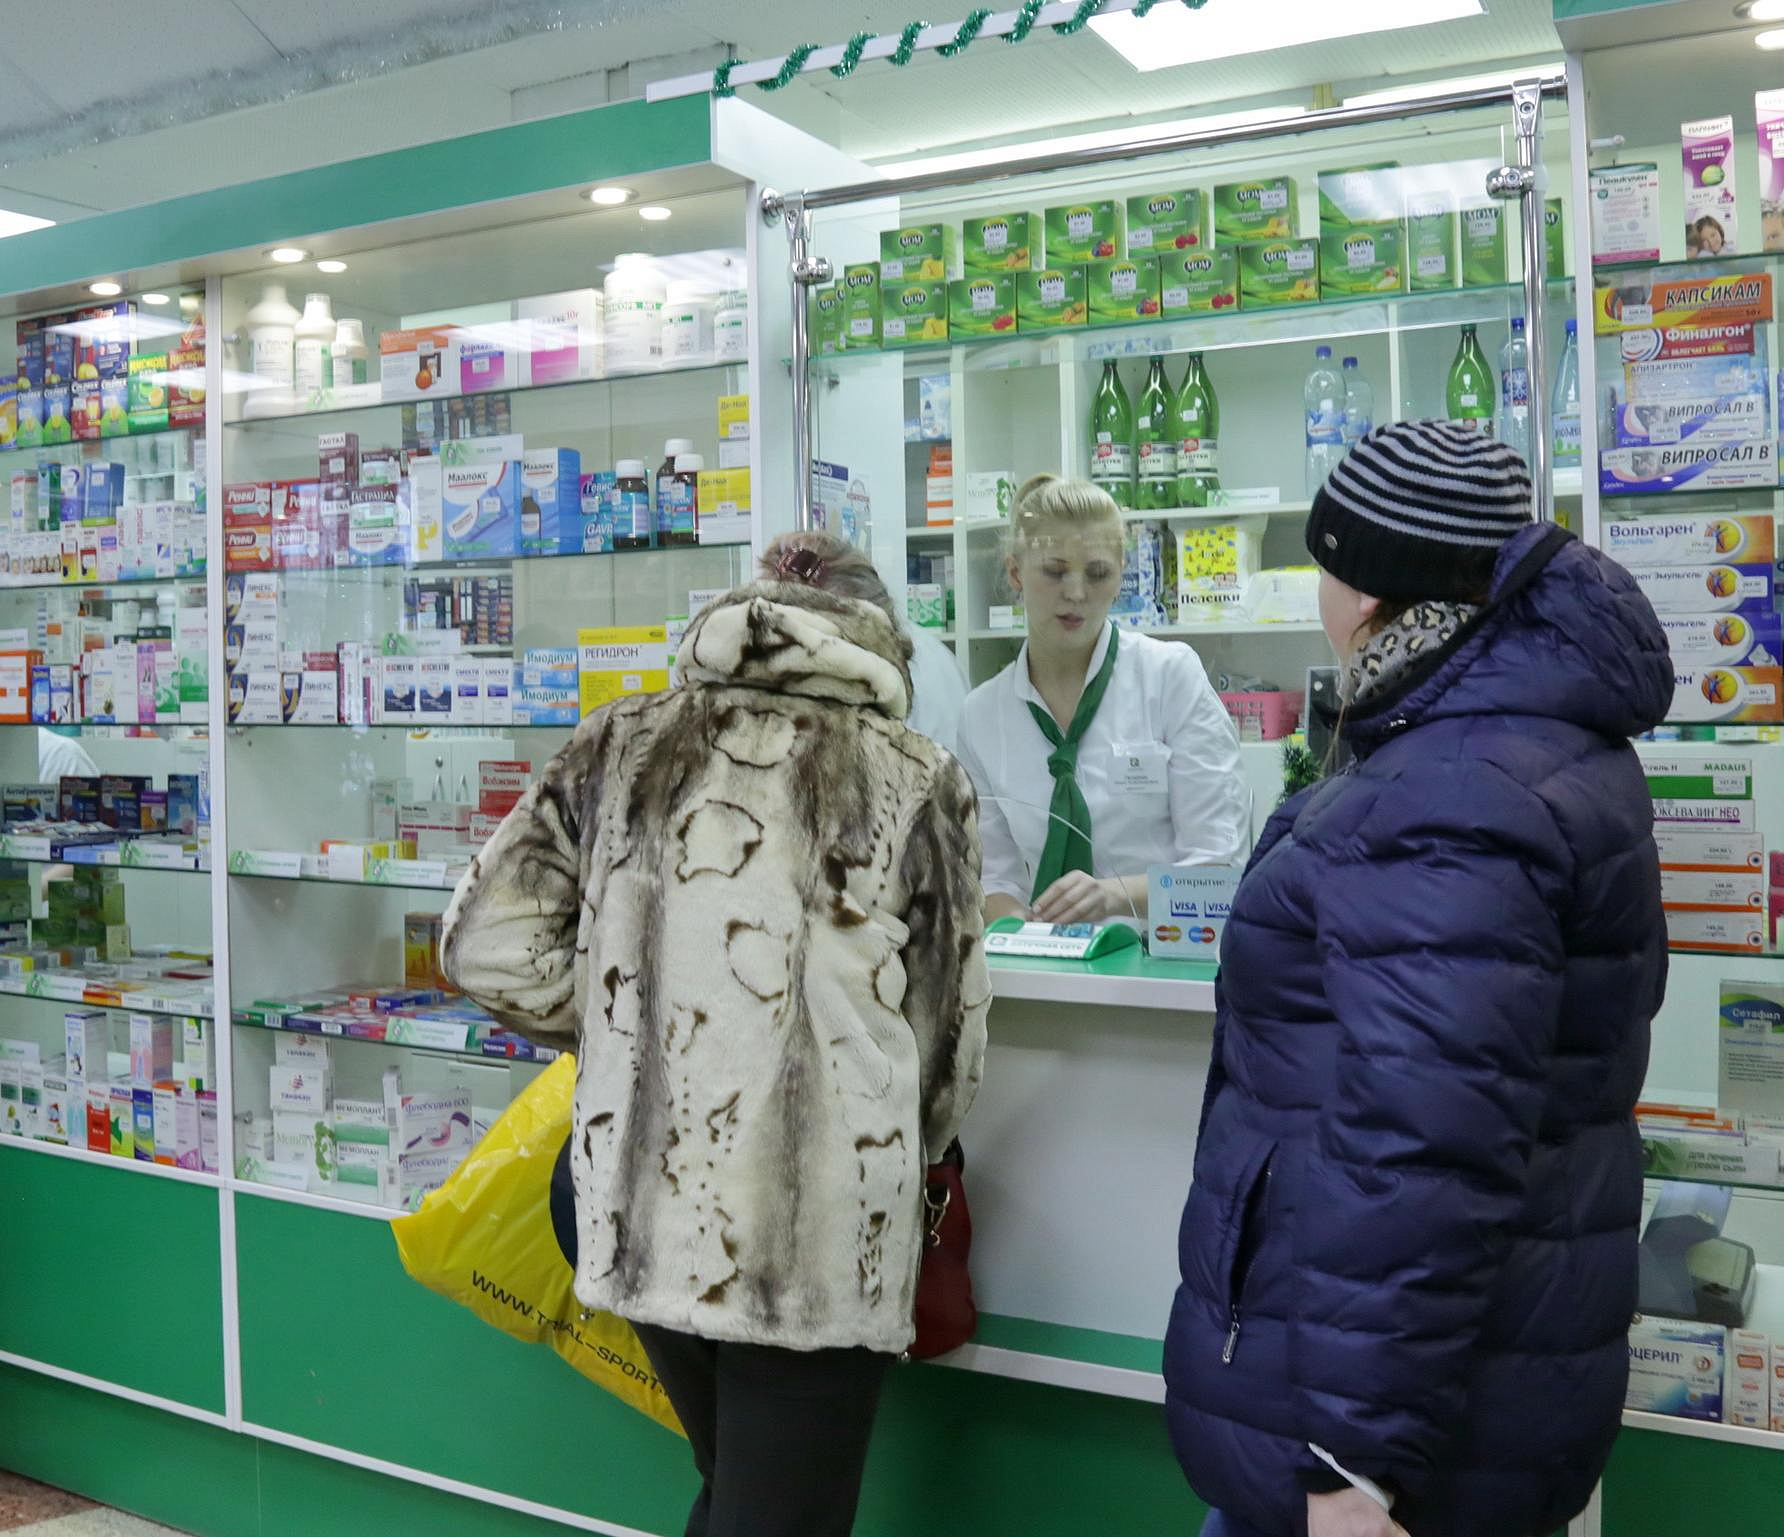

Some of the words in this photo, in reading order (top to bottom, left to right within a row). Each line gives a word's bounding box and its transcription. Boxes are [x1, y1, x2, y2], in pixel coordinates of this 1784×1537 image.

[1665, 281, 1761, 305] КАПСИКАМ
[1665, 325, 1745, 343] Финалгон
[1668, 402, 1742, 417] ВИПРОСАЛ
[1746, 401, 1754, 412] В
[1662, 447, 1752, 465] ВИПРОСАЛ
[1759, 446, 1769, 459] В
[1609, 523, 1694, 540] Вольтарен
[247, 632, 274, 642] ЛИНЕКС
[526, 652, 574, 667] Имодиум
[585, 646, 639, 660] РЕГИДРОН
[250, 681, 276, 692] ЛИНЕКС
[304, 680, 332, 691] ЛИНЕКС
[521, 689, 568, 704] Имодиум
[1704, 763, 1747, 771] MADAUS
[1653, 806, 1715, 818] ОКСЕВАЗИН
[1719, 807, 1741, 819] НЕО
[1175, 879, 1225, 889] открытие
[1174, 901, 1198, 912] VISA
[1208, 902, 1232, 912] VISA
[1627, 1346, 1681, 1364] ОЦЕРИЛ
